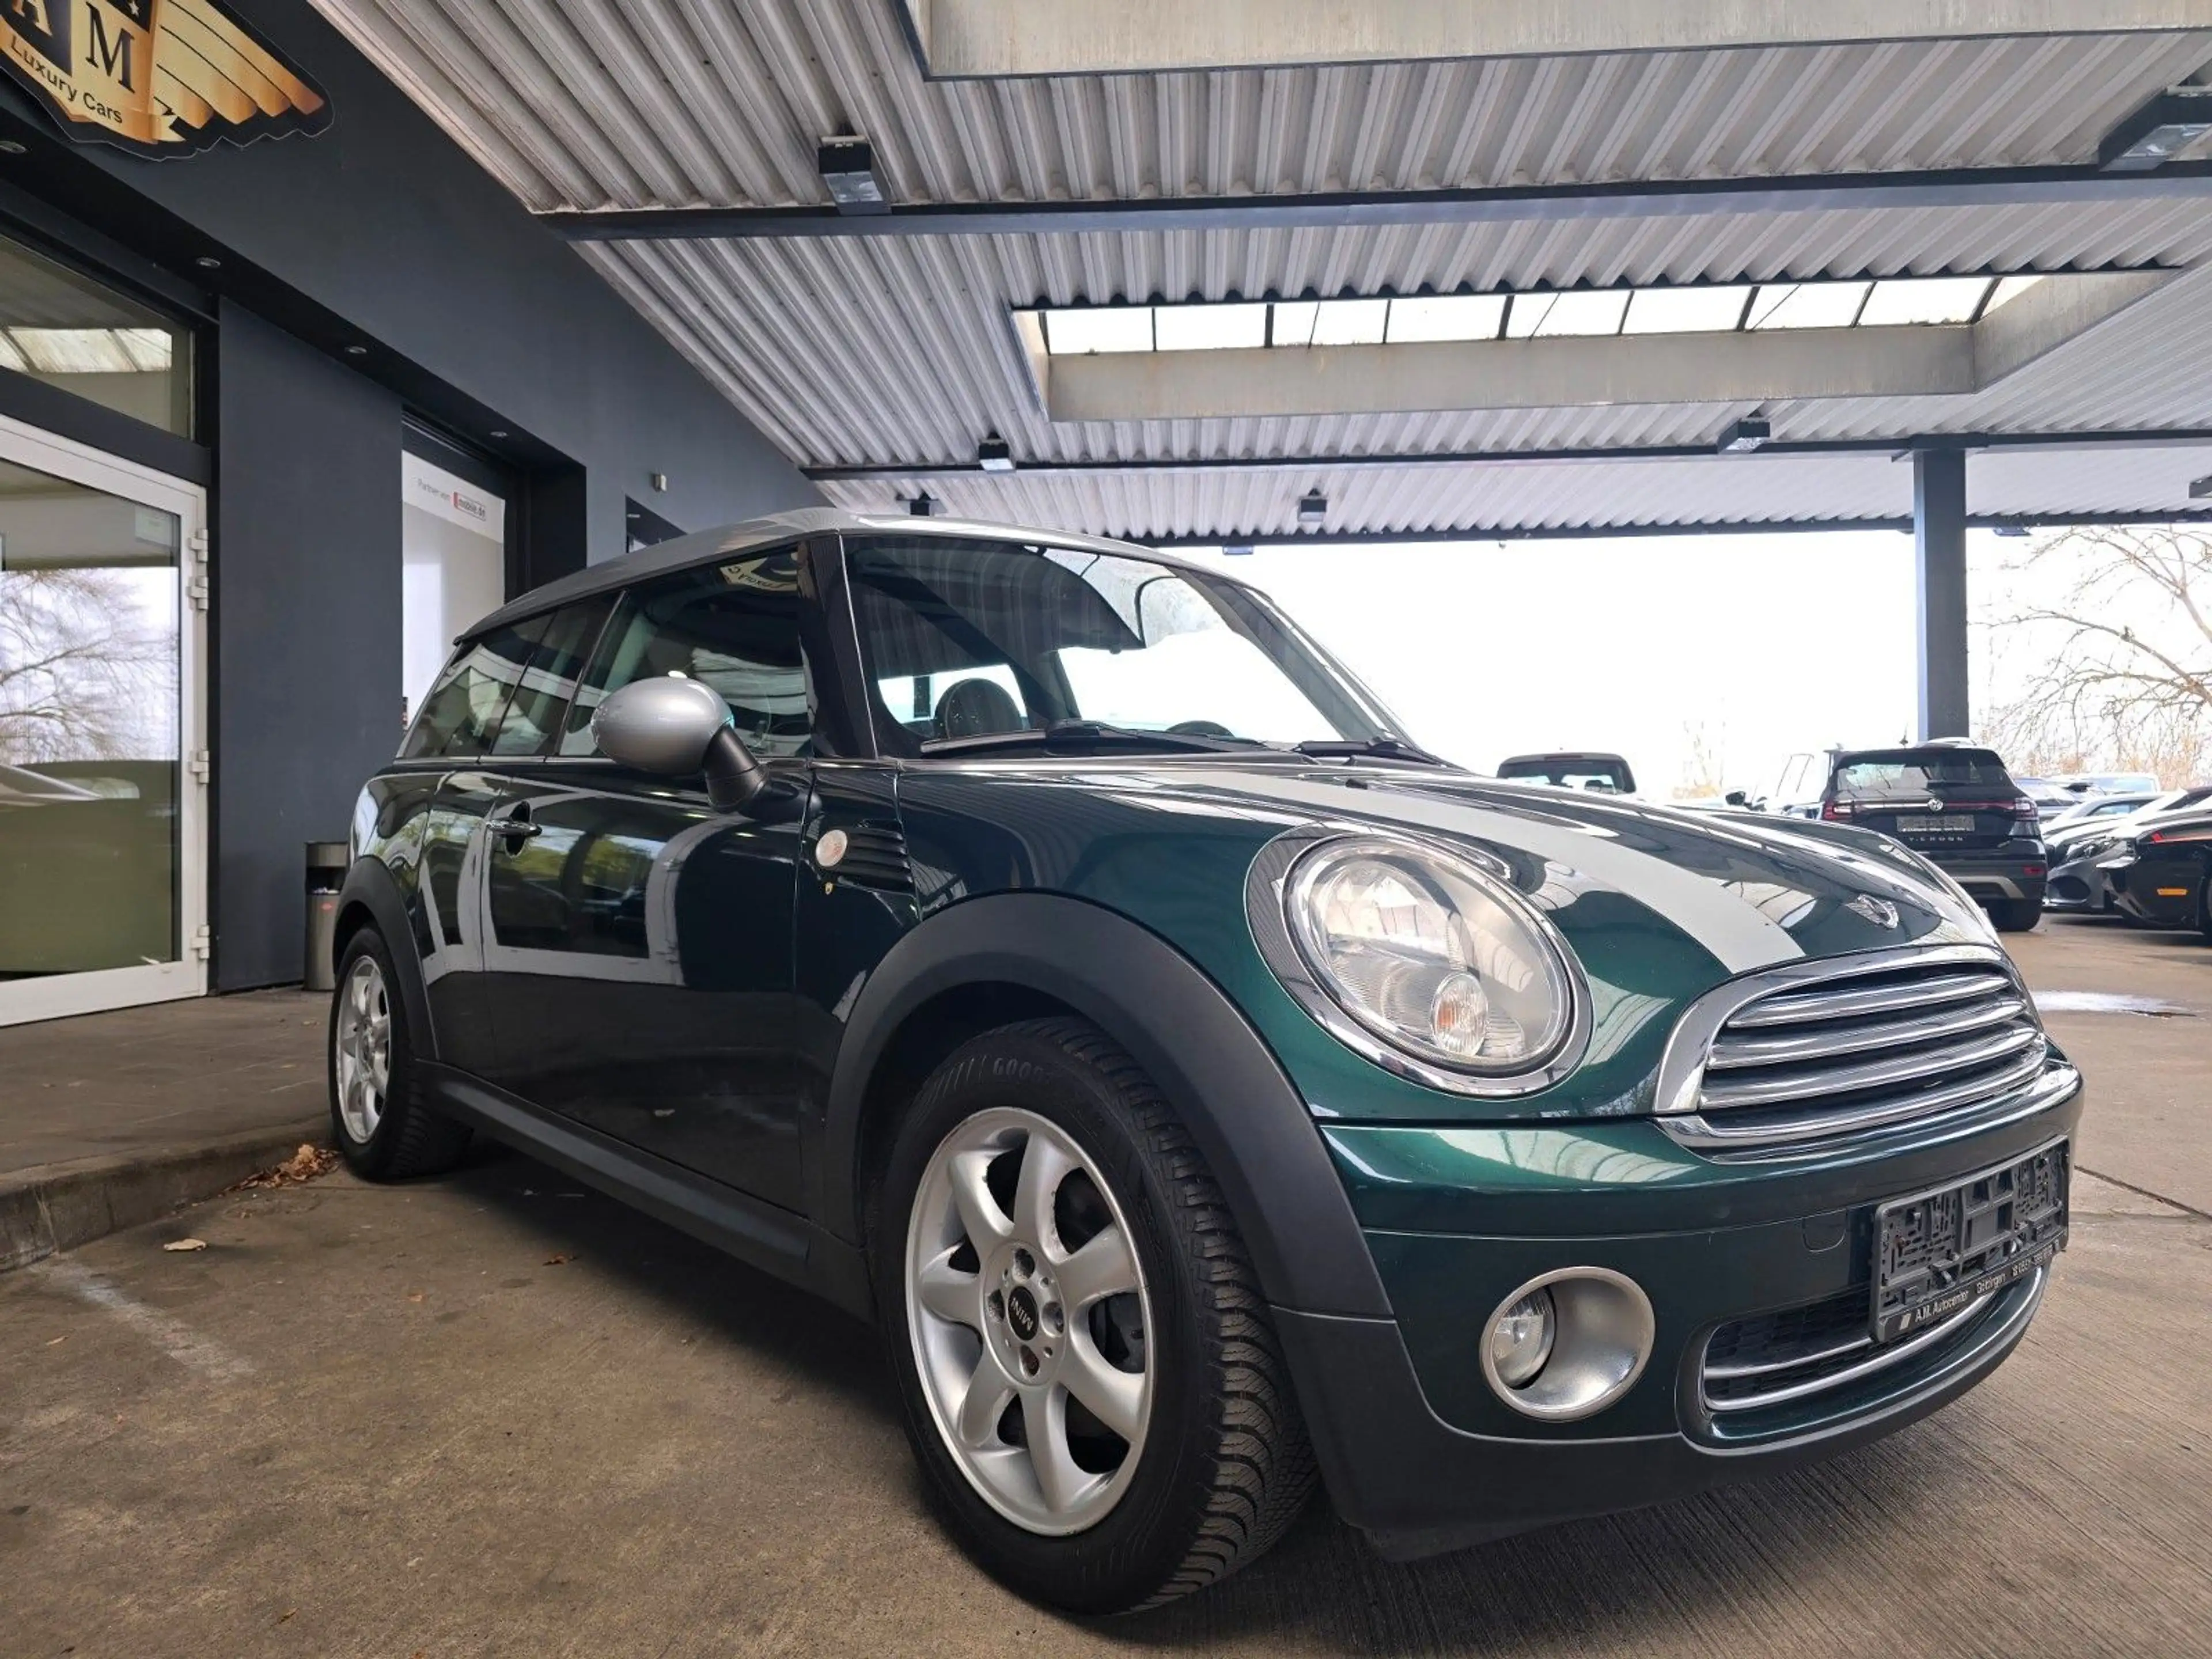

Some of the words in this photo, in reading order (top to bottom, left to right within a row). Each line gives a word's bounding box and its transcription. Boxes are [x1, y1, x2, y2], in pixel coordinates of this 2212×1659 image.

[11, 35, 78, 101] Luxury
[82, 92, 123, 123] Cars
[1010, 1297, 1034, 1331] MINI
